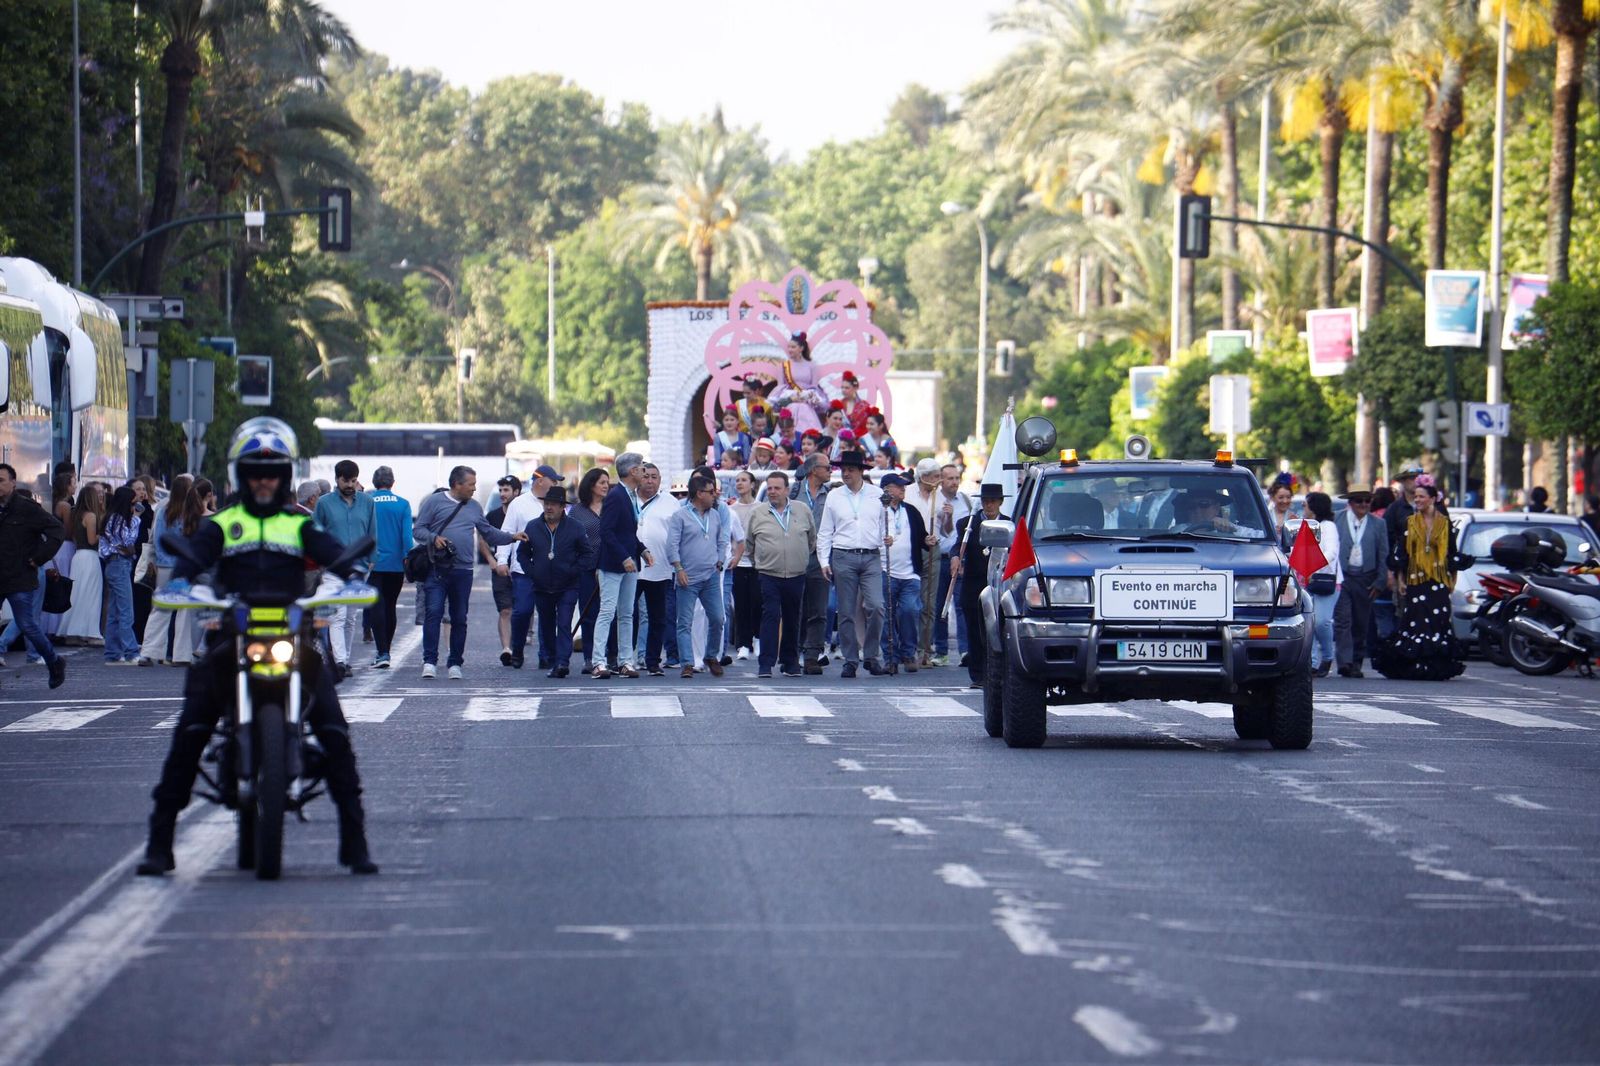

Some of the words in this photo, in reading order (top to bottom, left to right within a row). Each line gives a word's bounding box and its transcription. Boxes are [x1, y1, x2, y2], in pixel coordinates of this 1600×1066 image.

[689, 310, 713, 321] LOS
[373, 495, 399, 503] oma
[1112, 580, 1152, 591] Evento
[1155, 582, 1170, 591] en
[1173, 580, 1217, 591] marcha
[1133, 597, 1197, 610] CONTINÚE
[1128, 643, 1168, 658] 5419
[1173, 643, 1203, 658] CHN
